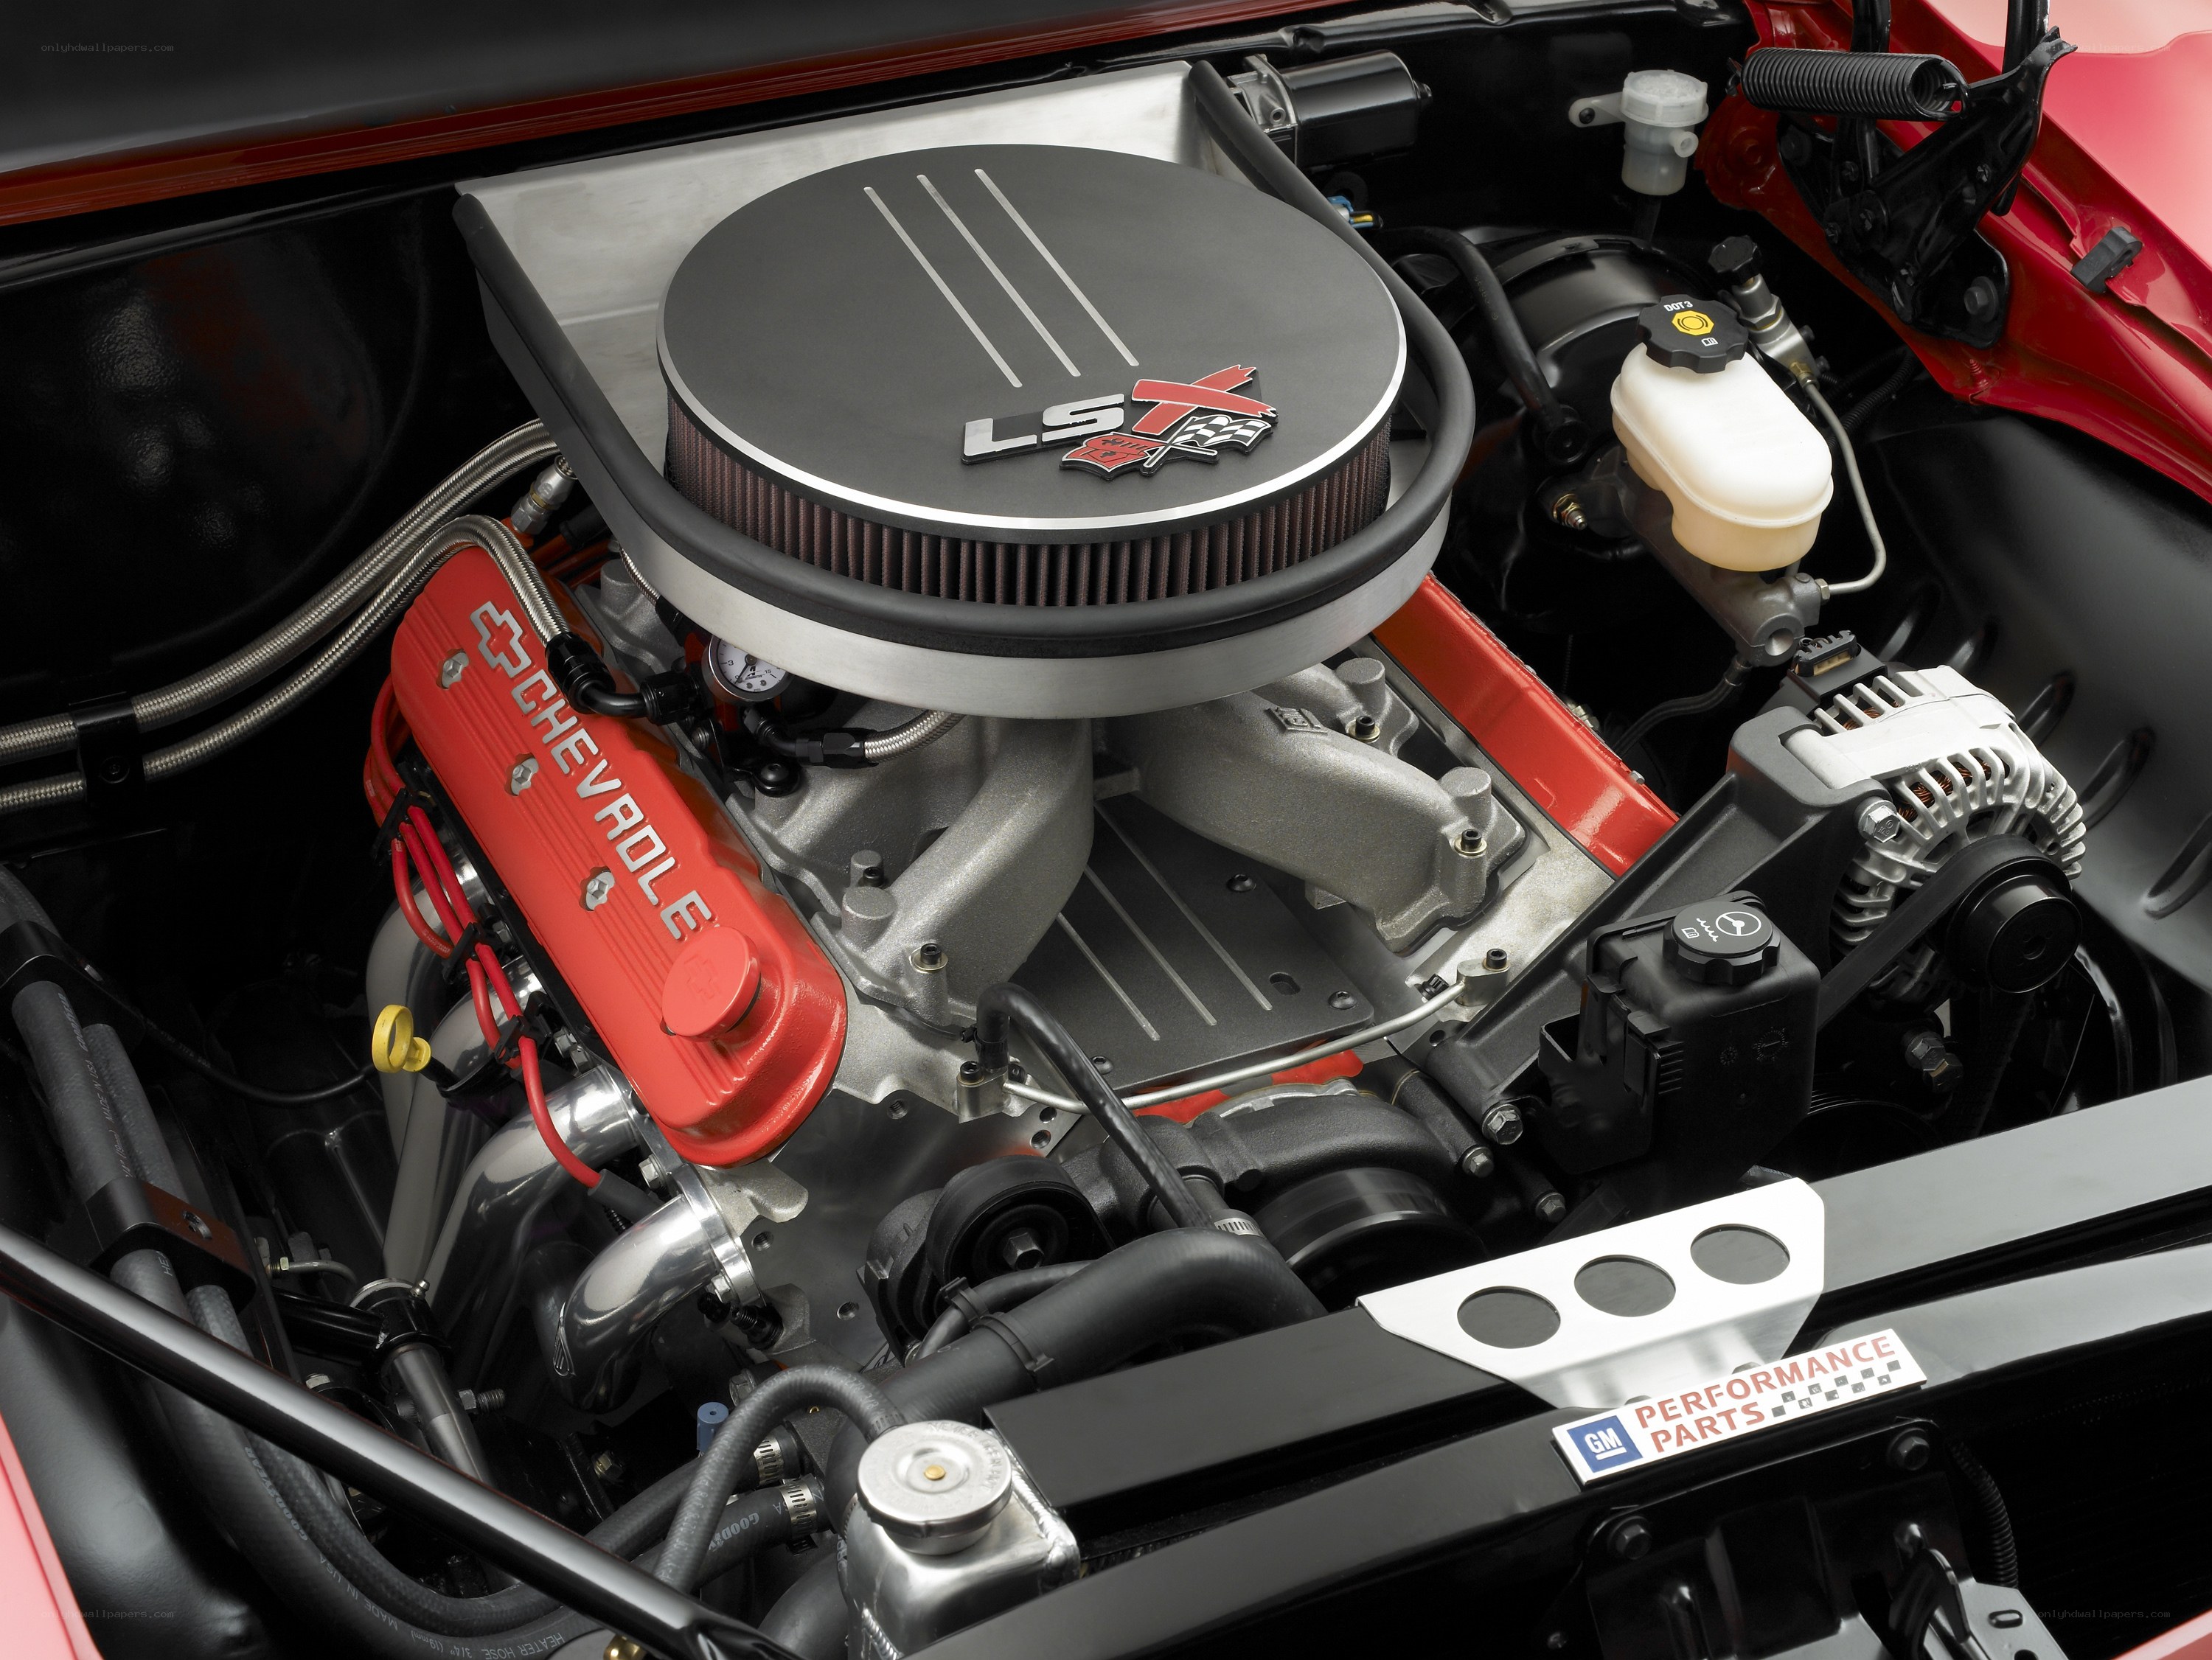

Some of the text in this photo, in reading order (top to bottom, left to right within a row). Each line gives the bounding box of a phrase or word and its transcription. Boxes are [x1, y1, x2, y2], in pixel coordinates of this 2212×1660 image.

[1663, 300, 1694, 312] DOT 3
[511, 669, 720, 941] CHEVROLE
[1634, 1336, 1896, 1429] PERFORMANCE
[1584, 1427, 1623, 1454] GM
[1650, 1401, 1765, 1453] PARTS
[244, 1446, 308, 1541] GOODYEAR
[708, 1513, 759, 1551] GOODY
[319, 1552, 342, 1583] USA
[347, 1584, 359, 1600] IN
[364, 1601, 399, 1631] MADE
[481, 1647, 515, 1660] HOSE
[520, 1632, 565, 1657] HEATER
